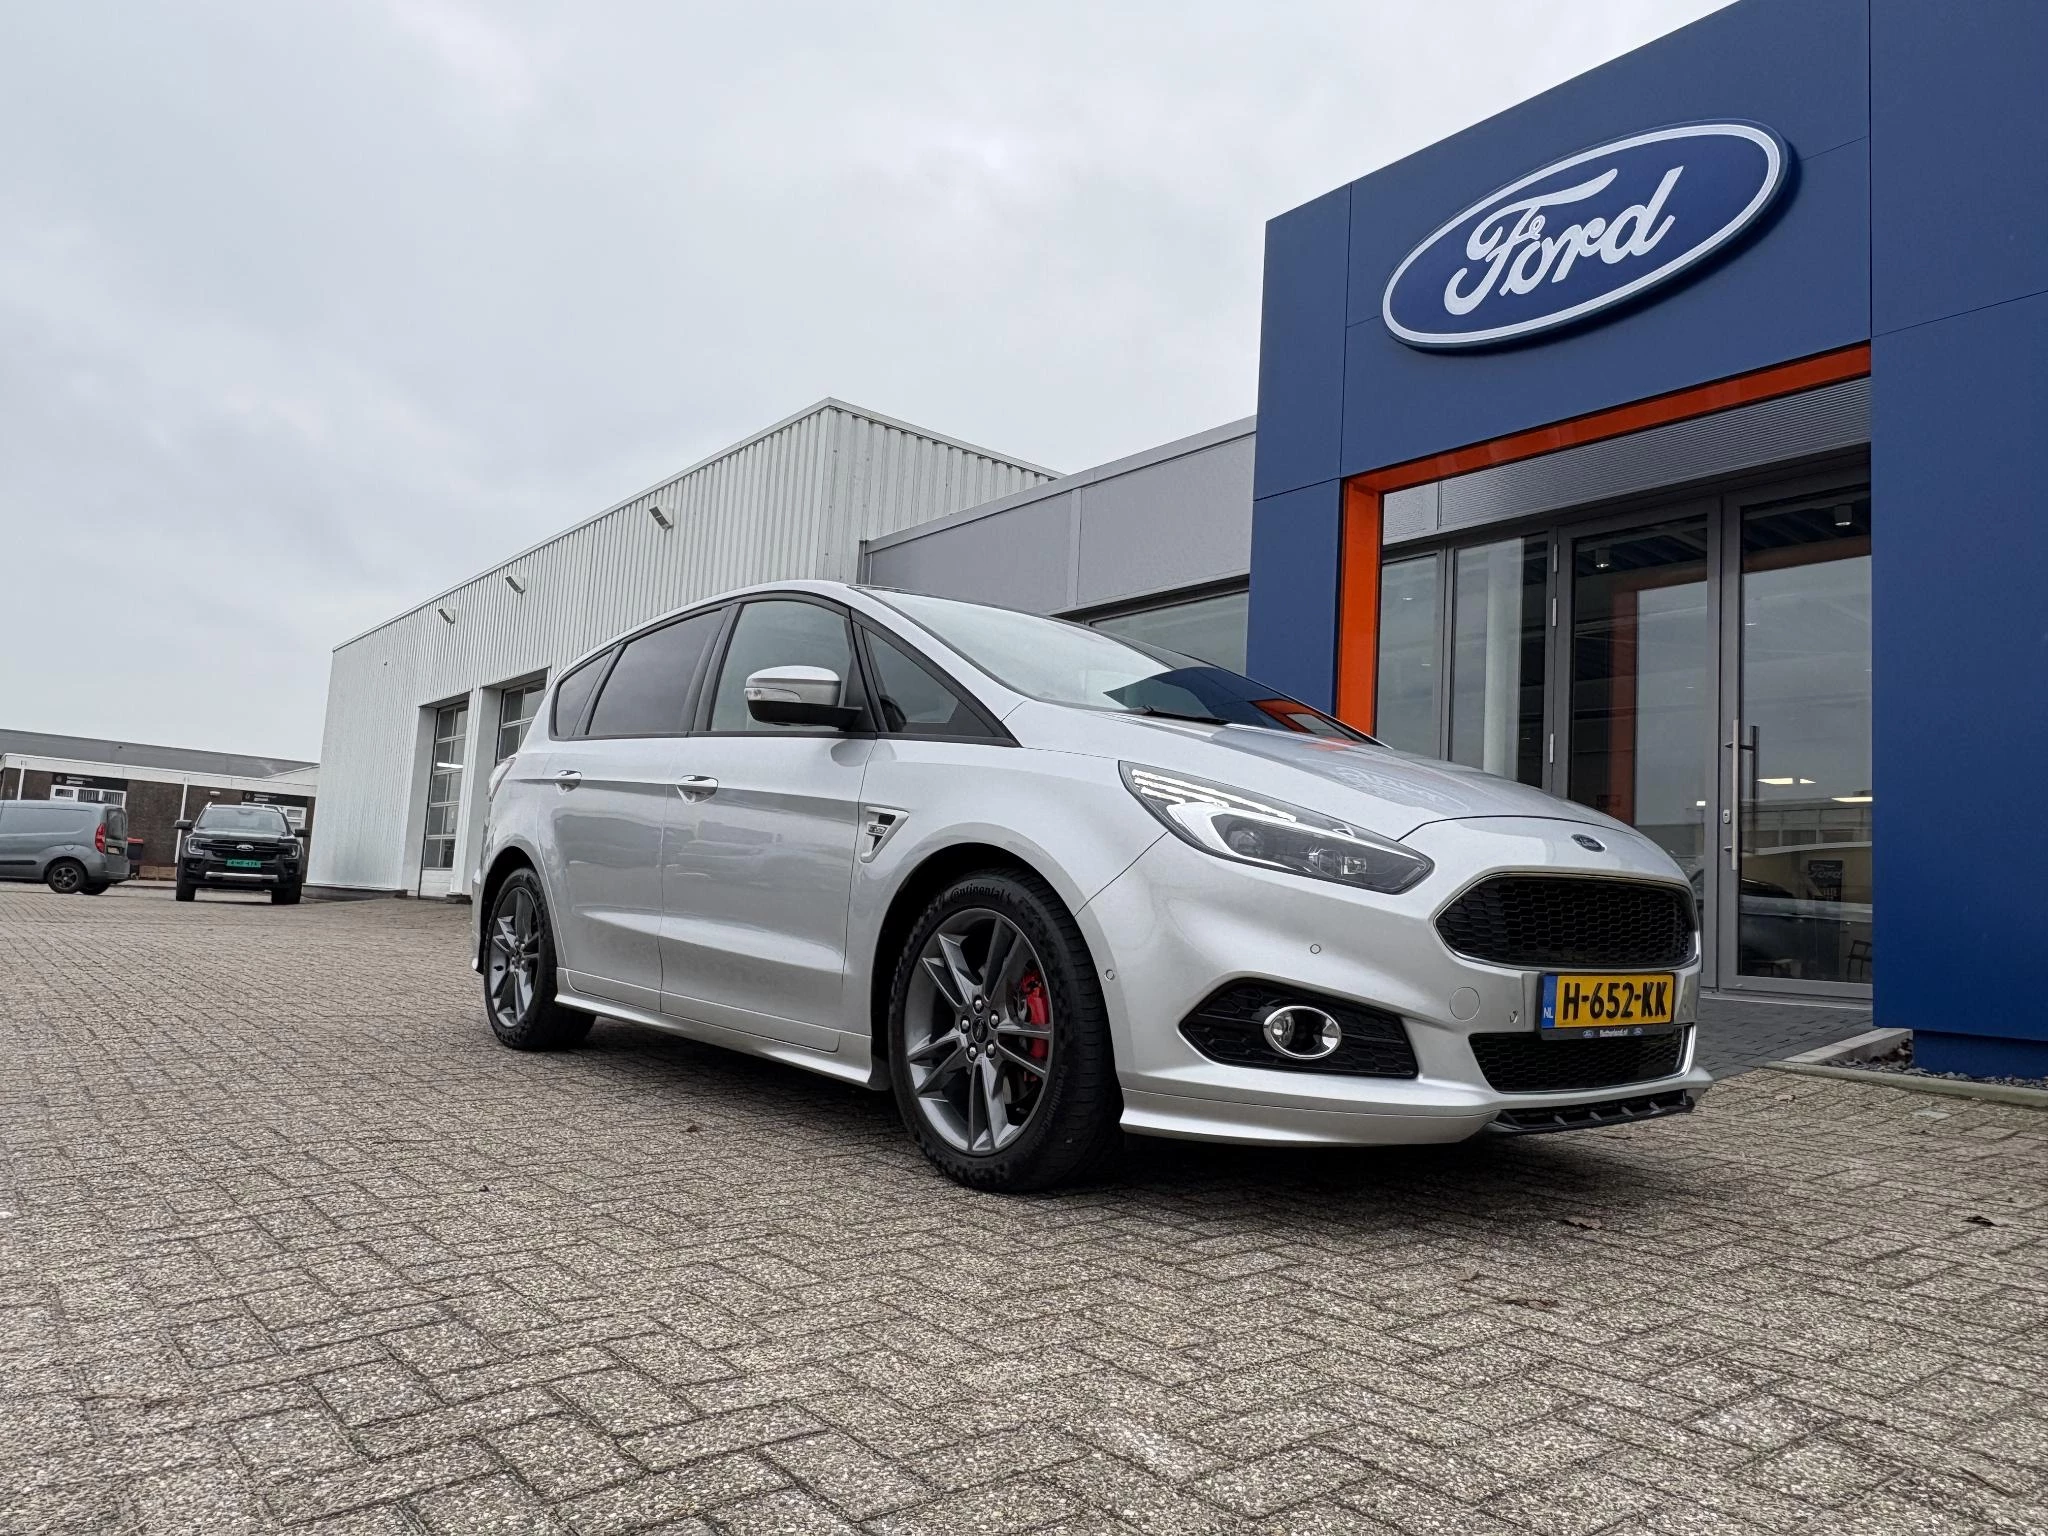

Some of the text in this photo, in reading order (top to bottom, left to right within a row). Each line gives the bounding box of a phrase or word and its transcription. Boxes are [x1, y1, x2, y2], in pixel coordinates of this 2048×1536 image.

[1443, 165, 1685, 316] Ford
[1543, 1007, 1554, 1019] NL
[1562, 981, 1667, 1020] H-652-KK
